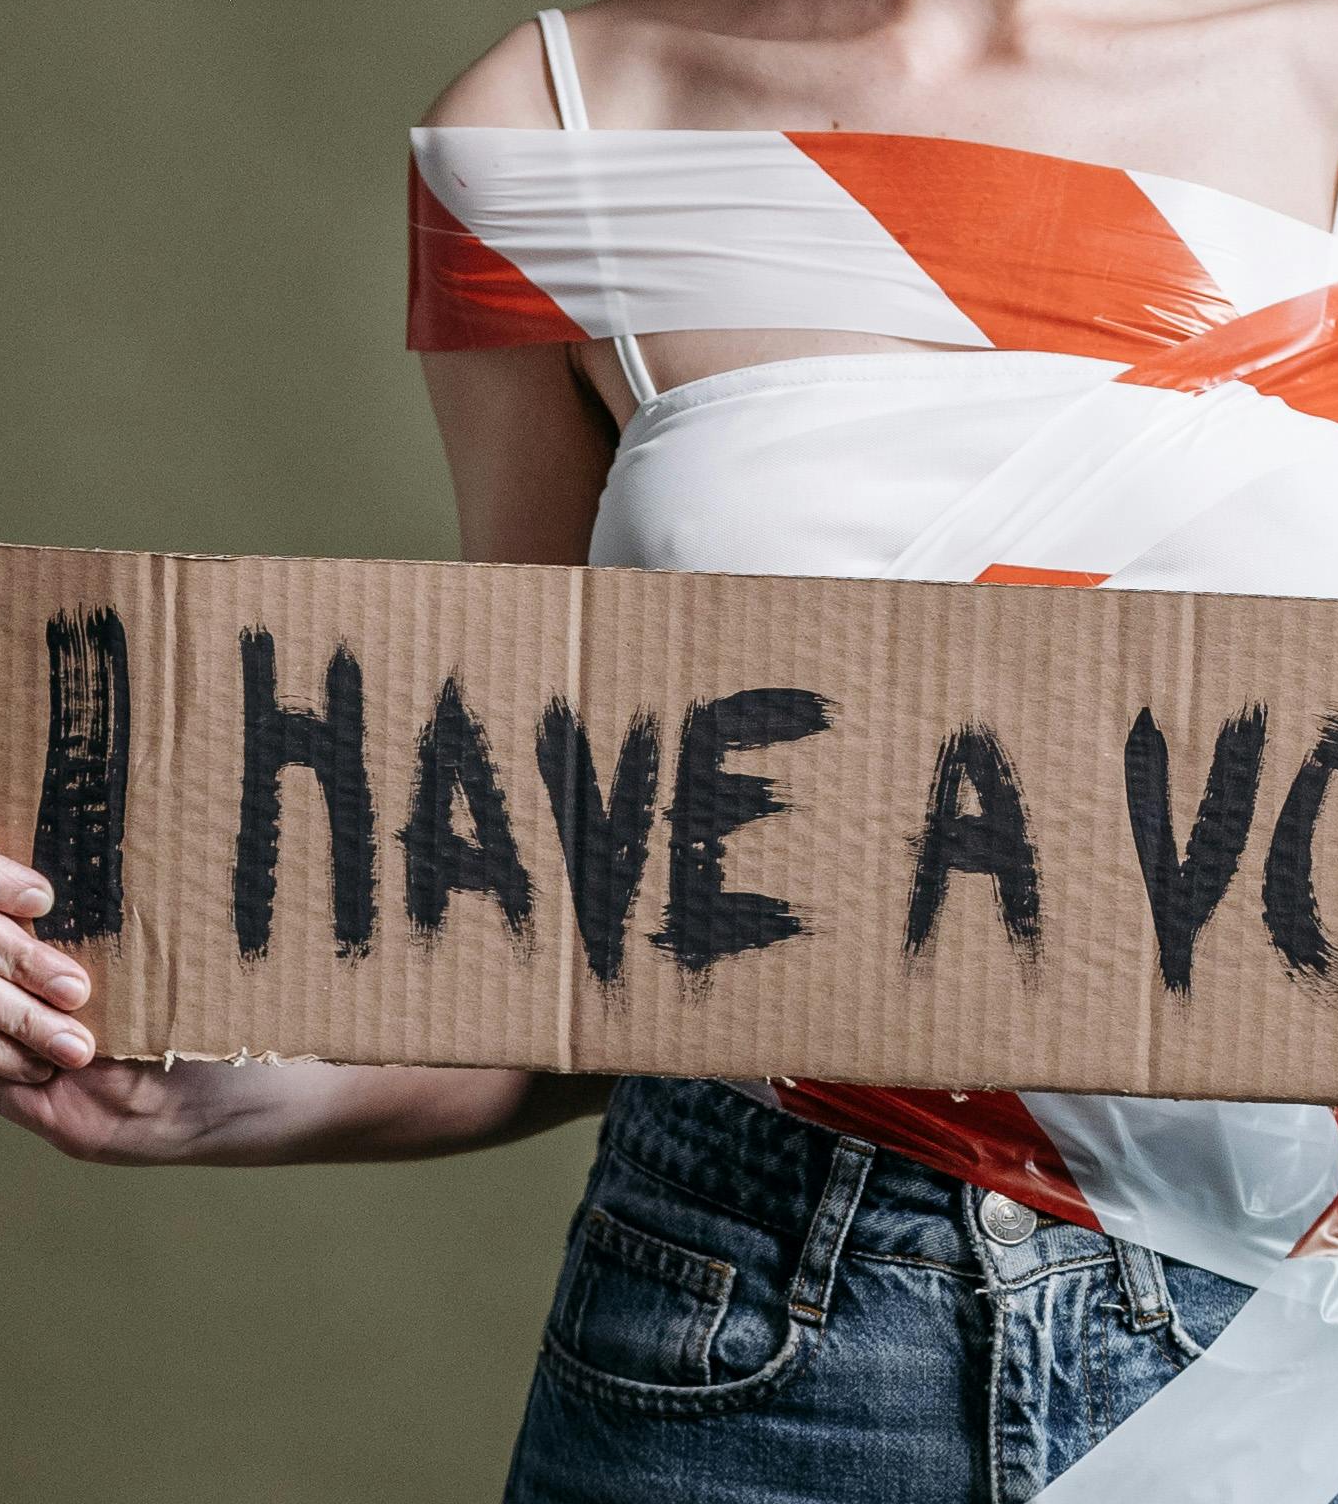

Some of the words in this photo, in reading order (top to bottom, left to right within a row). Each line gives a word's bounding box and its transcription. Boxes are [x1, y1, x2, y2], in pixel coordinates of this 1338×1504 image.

[32, 606, 131, 951] I
[229, 626, 835, 996] HAVE
[901, 722, 1045, 968] A
